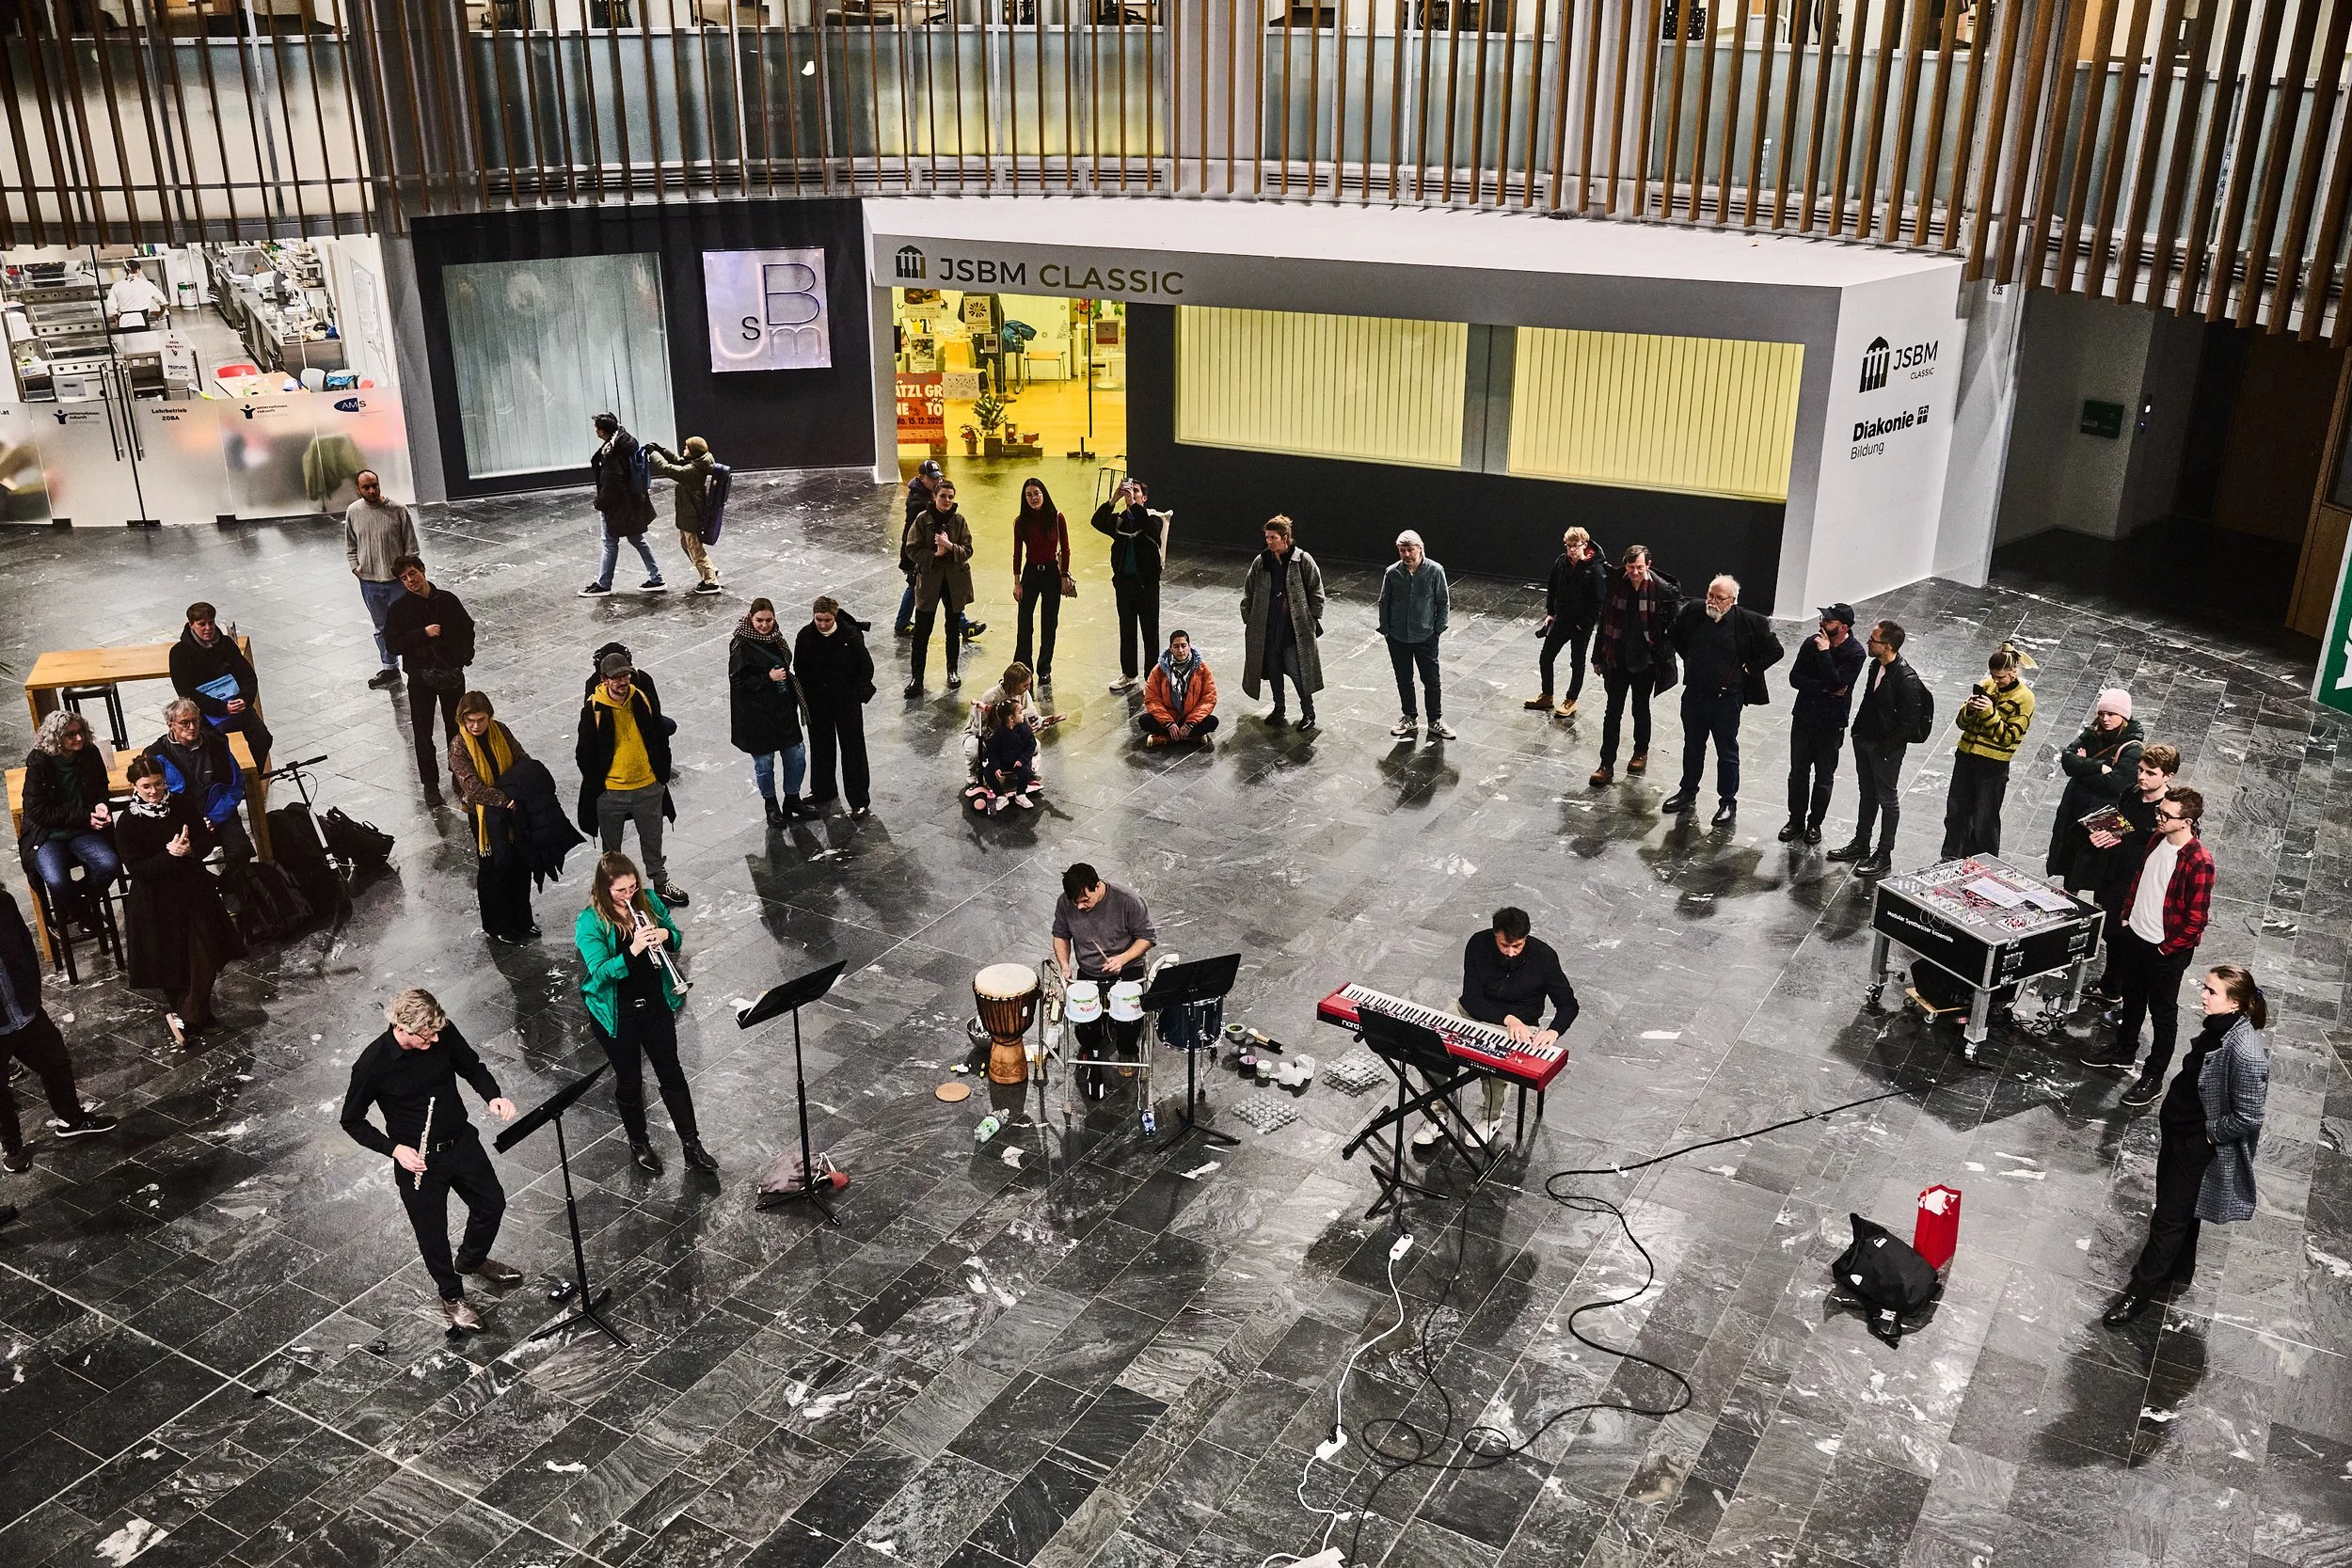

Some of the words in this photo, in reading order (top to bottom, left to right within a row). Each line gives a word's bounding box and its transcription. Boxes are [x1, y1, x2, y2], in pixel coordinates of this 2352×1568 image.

[939, 257, 1026, 286] JSBM
[1039, 264, 1184, 295] CLASSIC
[1893, 340, 1939, 371] JSBM
[1910, 367, 1935, 380] CLASSIC
[342, 400, 367, 409] AMS
[1852, 410, 1915, 442] Diakonie
[1851, 442, 1884, 460] Bildung
[1887, 911, 1905, 922] Modular
[1905, 917, 1931, 933] Synthesizer
[1931, 929, 1954, 943] Ensemble
[1342, 1020, 1359, 1030] nord
